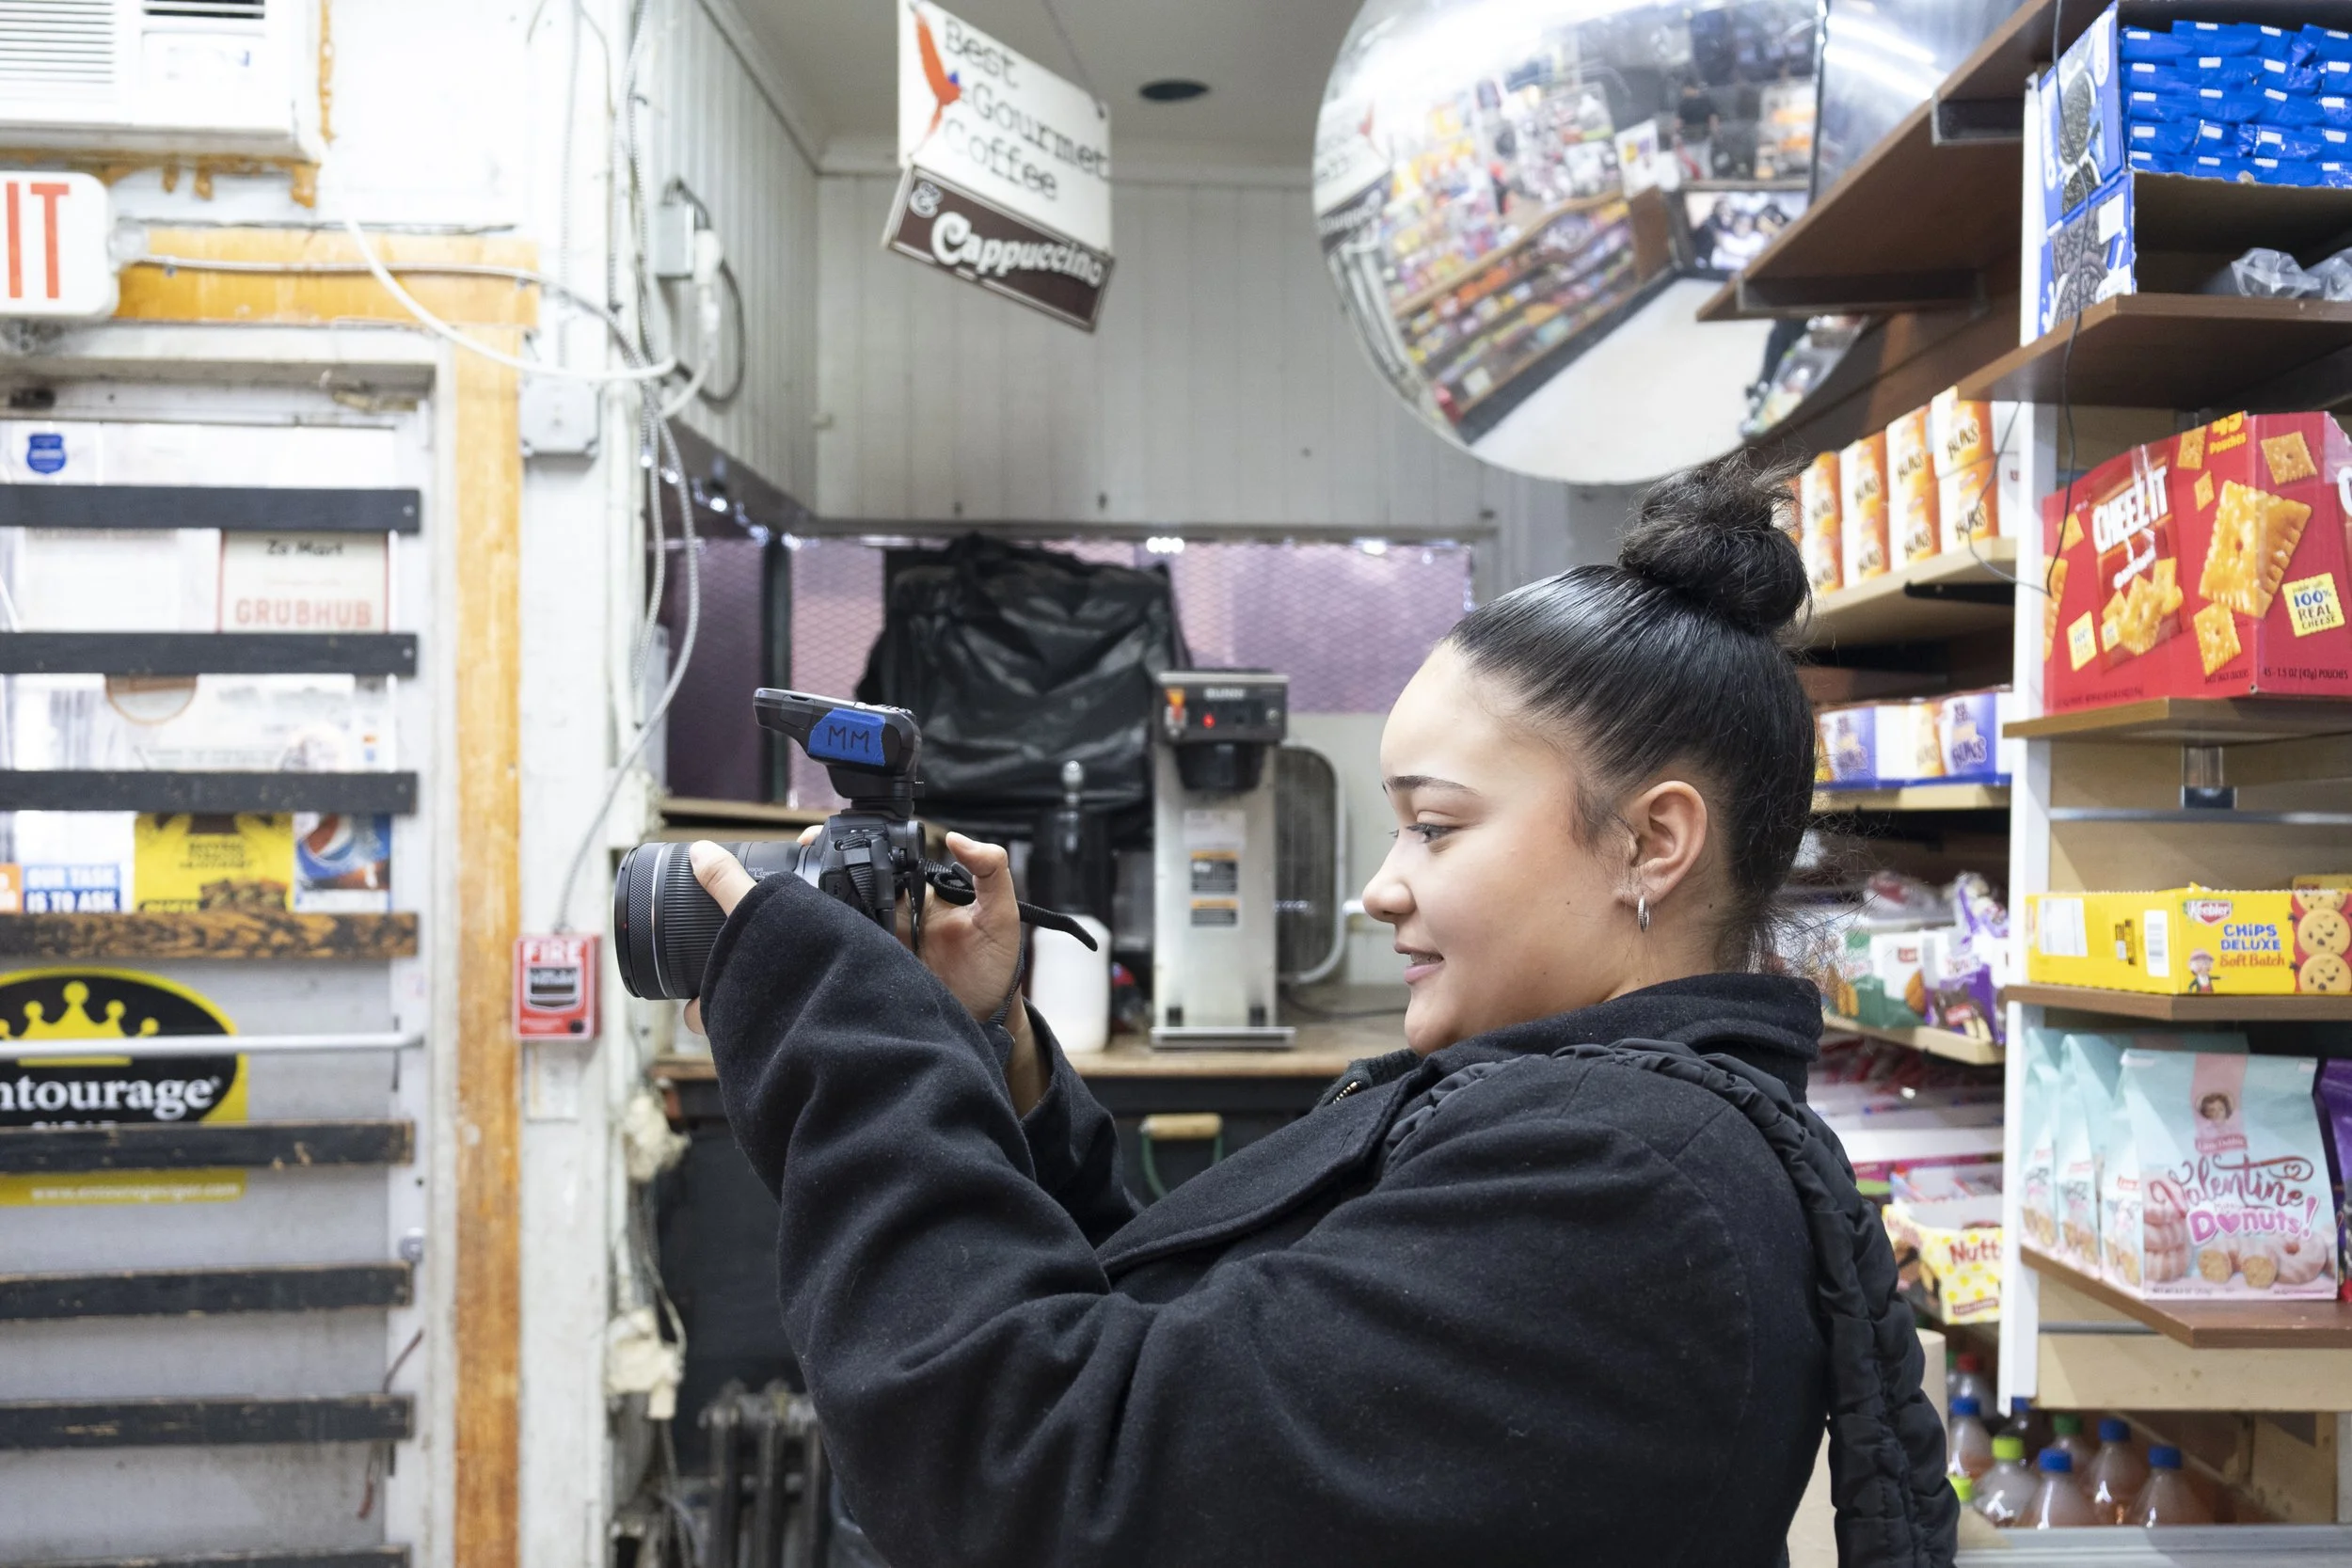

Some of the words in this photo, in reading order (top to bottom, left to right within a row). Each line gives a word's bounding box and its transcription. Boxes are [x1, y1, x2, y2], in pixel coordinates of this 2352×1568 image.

[945, 20, 1019, 88] Best
[973, 82, 1111, 181] Gourmet
[943, 117, 1058, 201] Coffee
[930, 211, 1104, 289] Cappuccino
[2294, 590, 2332, 608] 100%
[234, 597, 373, 627] GRUBHUB
[2297, 604, 2331, 622] REAL
[2301, 616, 2336, 630] CHEESE
[2318, 669, 2349, 680] POUCHES
[827, 724, 870, 753] MM
[2188, 900, 2231, 918] Keebler
[523, 939, 583, 964] FIRE
[2220, 939, 2281, 951] DELUXE
[2220, 954, 2247, 967] Soft
[2249, 952, 2285, 967] Batch
[2149, 1153, 2314, 1219] Valentine
[1949, 1240, 2002, 1265] Nutt
